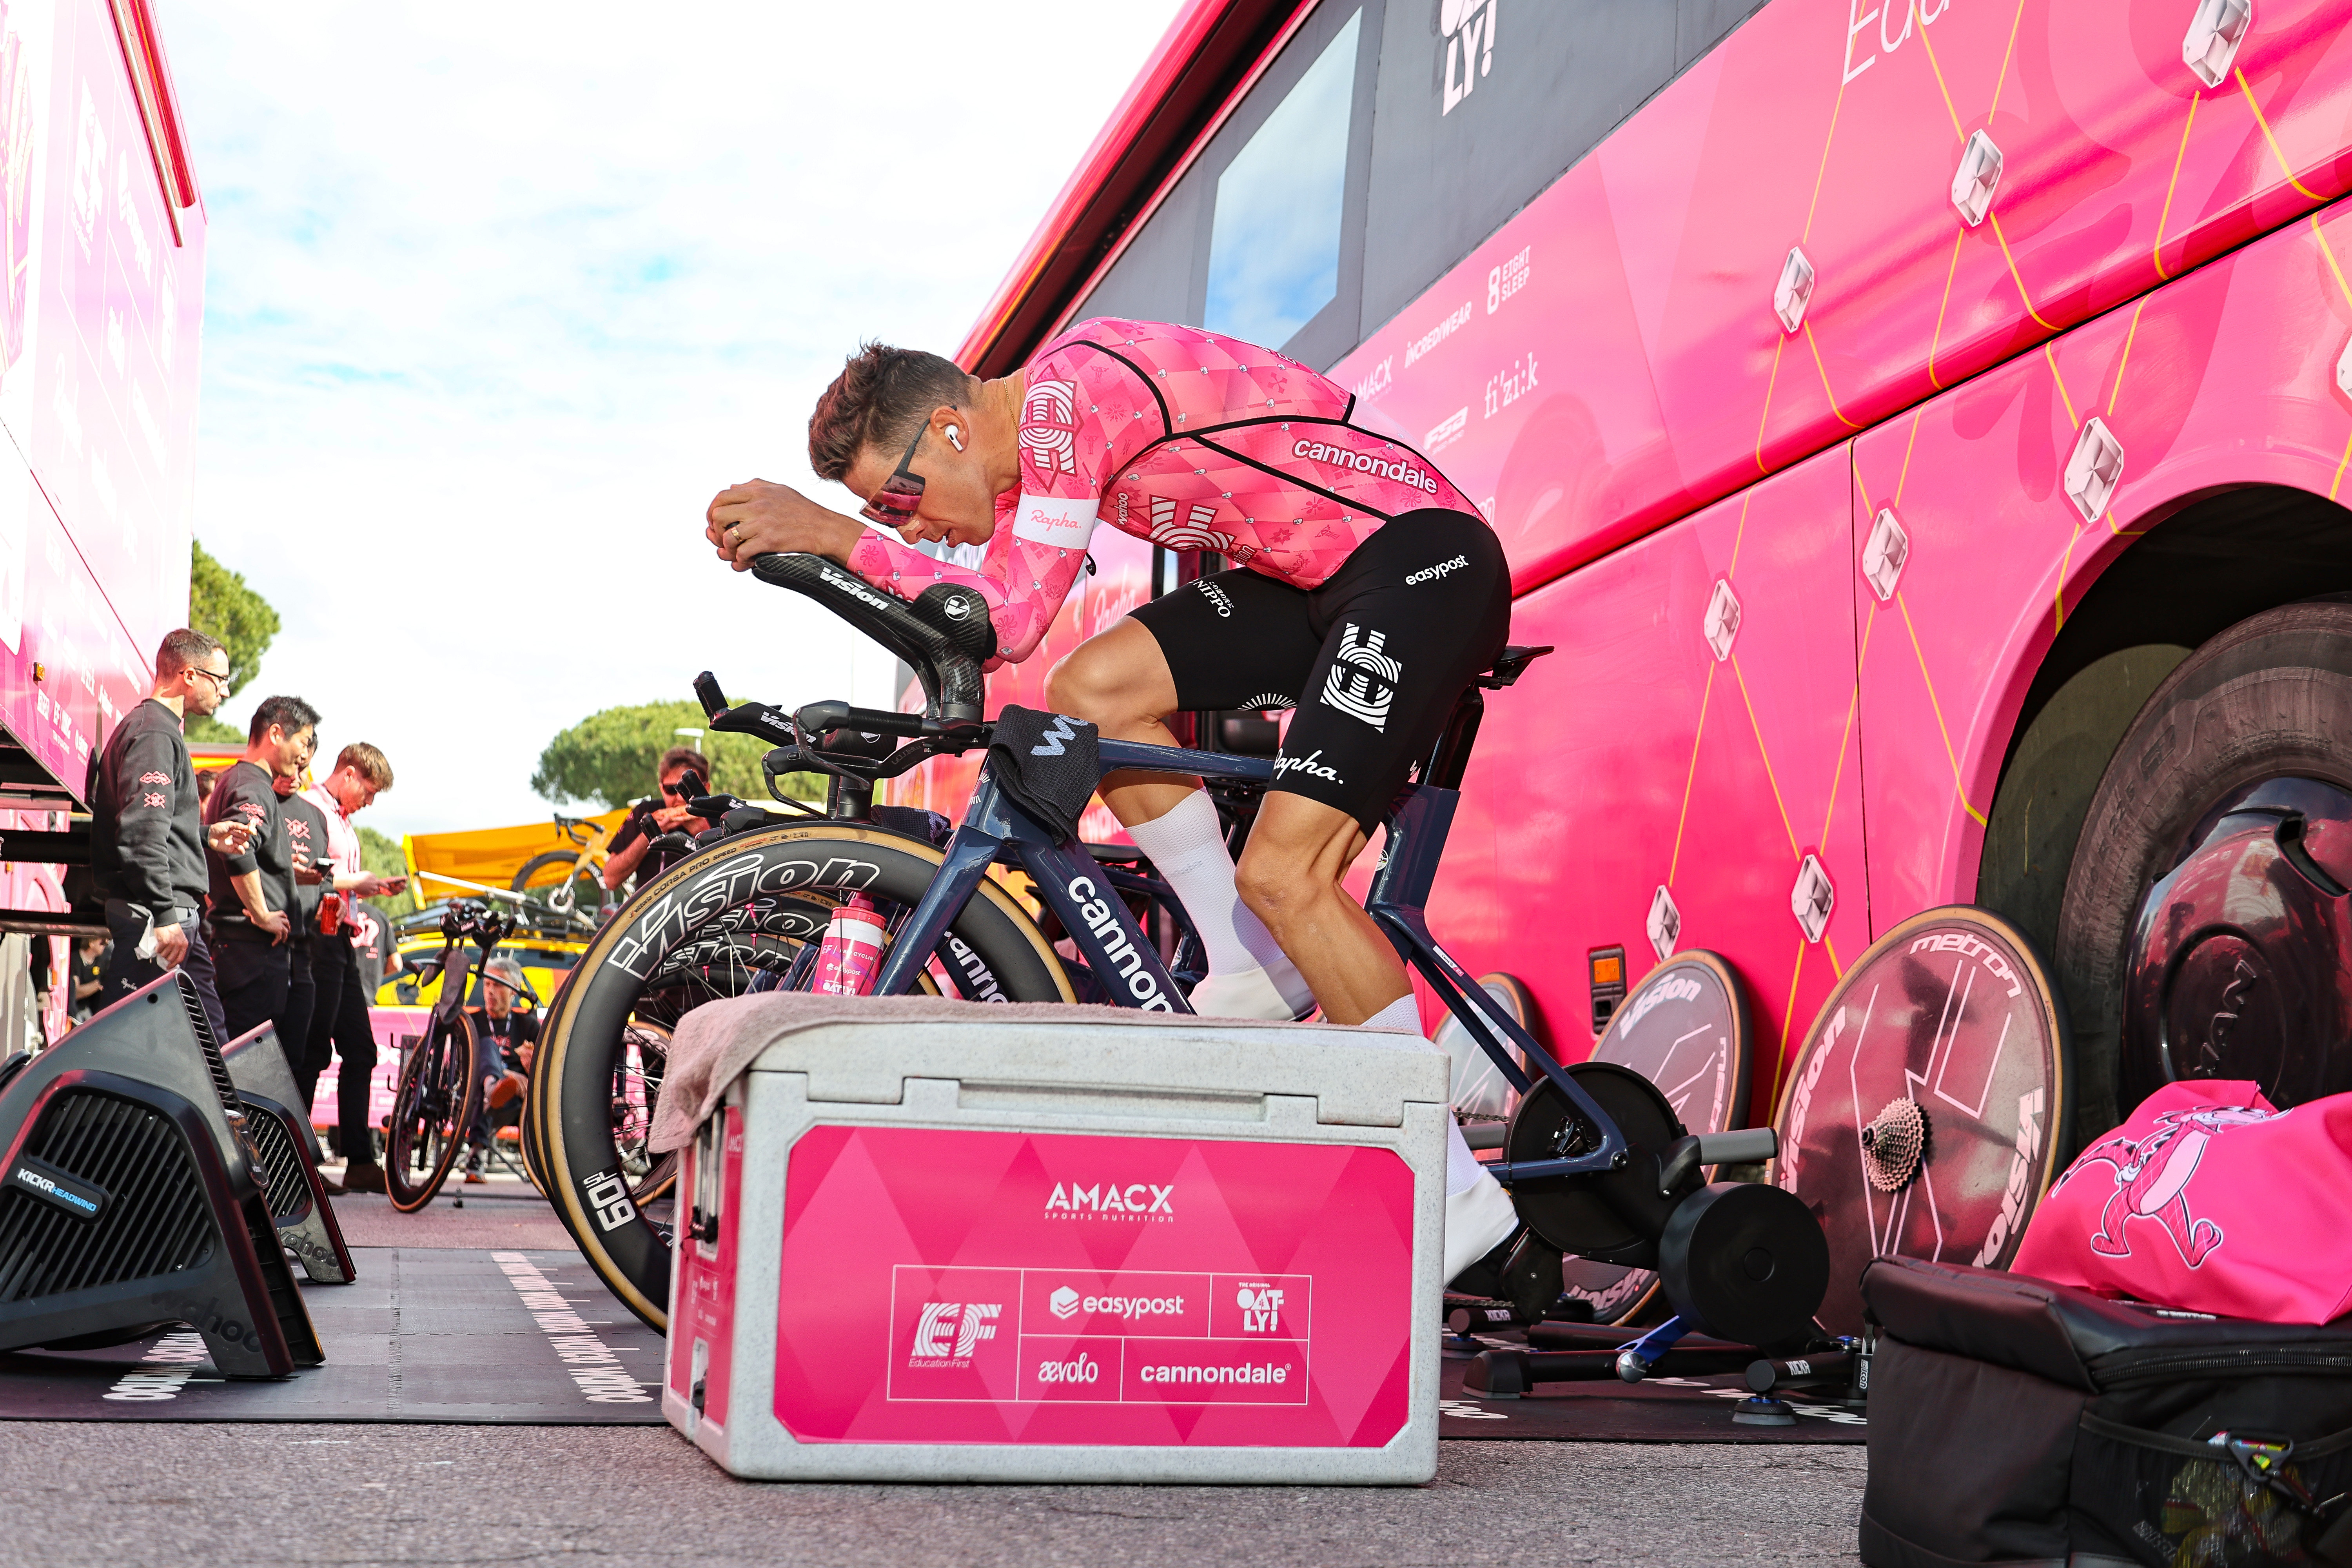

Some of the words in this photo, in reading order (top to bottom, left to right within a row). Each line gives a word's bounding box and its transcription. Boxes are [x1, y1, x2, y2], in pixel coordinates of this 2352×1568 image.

[1502, 245, 1531, 281] EIGHT
[1487, 265, 1501, 315] 8
[1501, 265, 1530, 302] SLEEP
[1294, 438, 1438, 493] cannondale
[1031, 509, 1082, 532] Rapha.
[1116, 492, 1129, 526] wahoo
[1405, 554, 1469, 586] easypost
[818, 566, 889, 611] Vision
[1192, 579, 1230, 618] NIPPO
[759, 710, 817, 744] Visin
[653, 873, 686, 897] CORSA
[689, 857, 710, 873] PRO
[712, 847, 736, 860] SPEED
[608, 853, 881, 981] Vision
[821, 944, 833, 954] EF
[853, 951, 876, 963] CYCLIN
[1909, 933, 2022, 998] metron
[1619, 973, 1702, 1040] Vision
[17, 1167, 56, 1193] KICKR
[51, 1185, 97, 1212] HEADWIND
[1973, 1085, 2045, 1269] Visio
[1045, 1181, 1174, 1213] AMACX
[1045, 1212, 1093, 1221] SPORTS
[1082, 1294, 1184, 1319] easypost
[1243, 1310, 1279, 1332] LY!
[1484, 1309, 1511, 1322] KICKR
[911, 1302, 1002, 1357] EF
[568, 1367, 654, 1403] wahoo
[1785, 1360, 1811, 1376] KICKR
